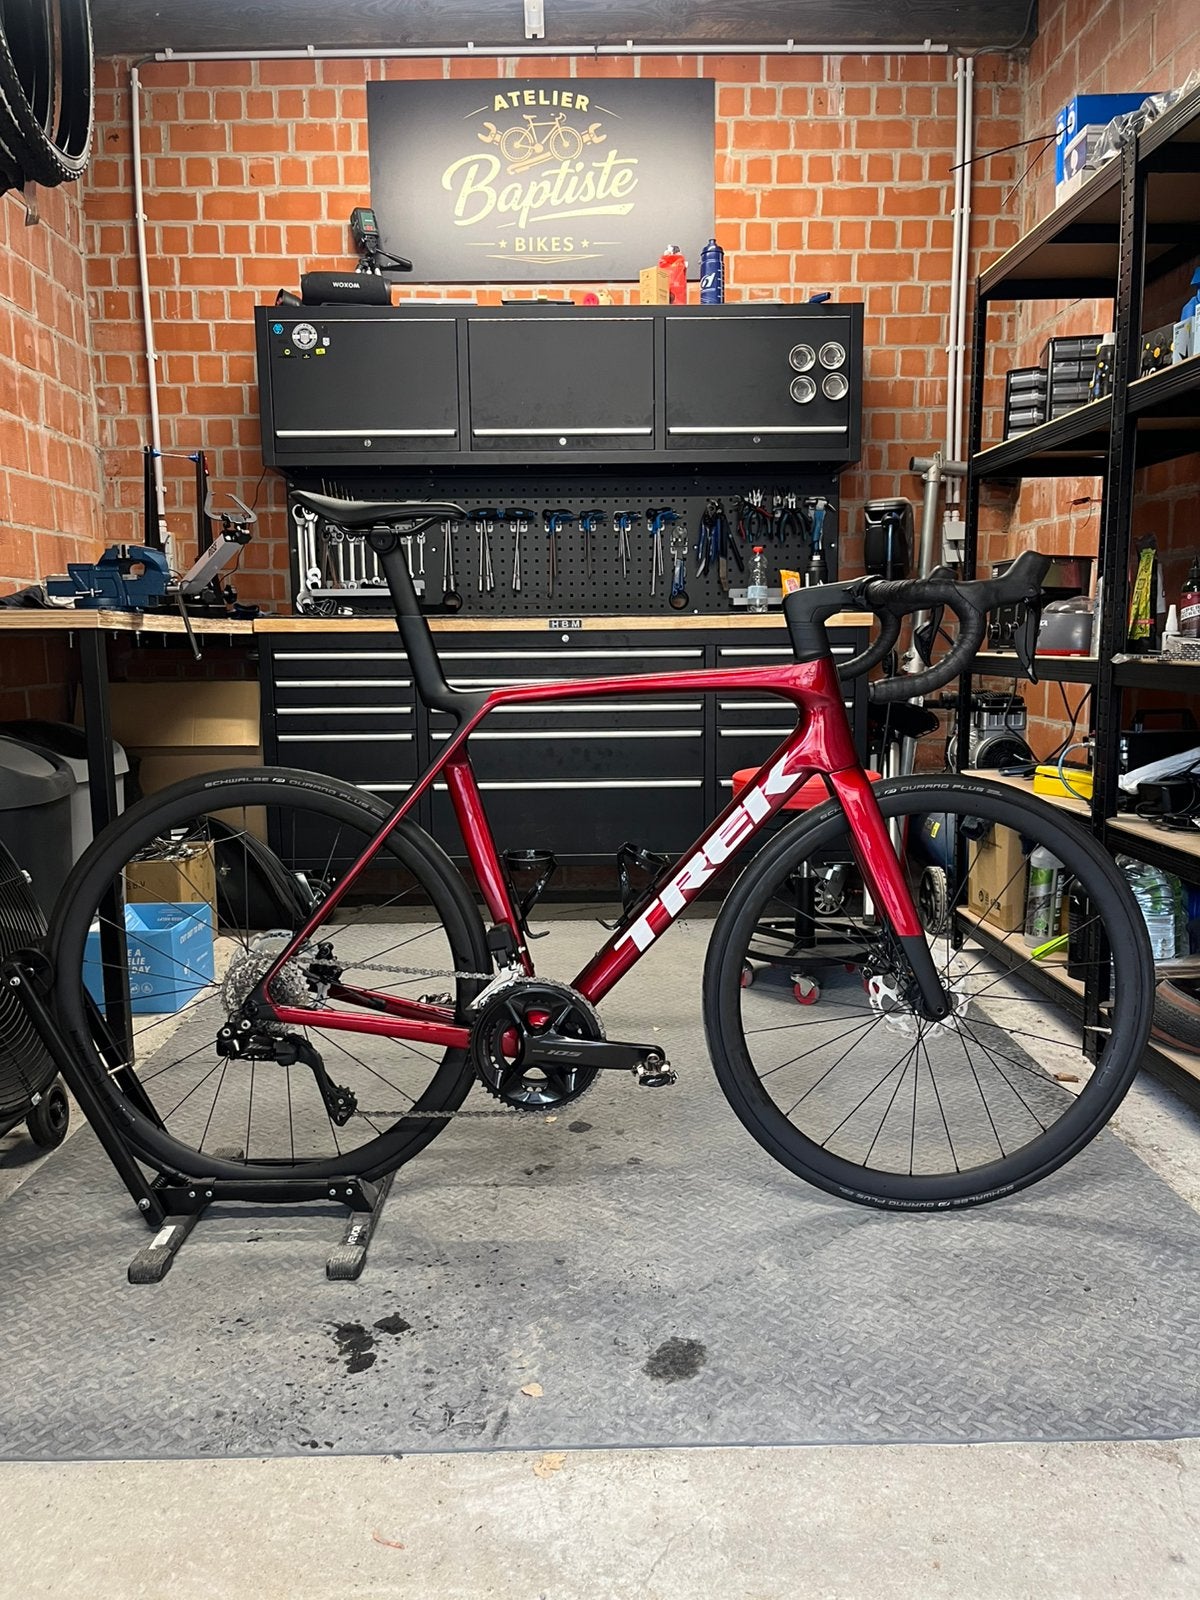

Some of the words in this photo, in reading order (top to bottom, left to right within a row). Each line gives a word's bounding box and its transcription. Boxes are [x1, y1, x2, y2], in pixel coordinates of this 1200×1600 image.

[494, 89, 590, 112] ATELIER
[441, 149, 639, 229] Baptiste
[514, 236, 574, 252] BIKES
[332, 281, 361, 289] WOXOM
[551, 620, 580, 628] HBM
[204, 777, 270, 789] SCHWALBE
[338, 792, 370, 809] PLUS
[951, 784, 985, 793] PLUS
[613, 750, 803, 953] TREK
